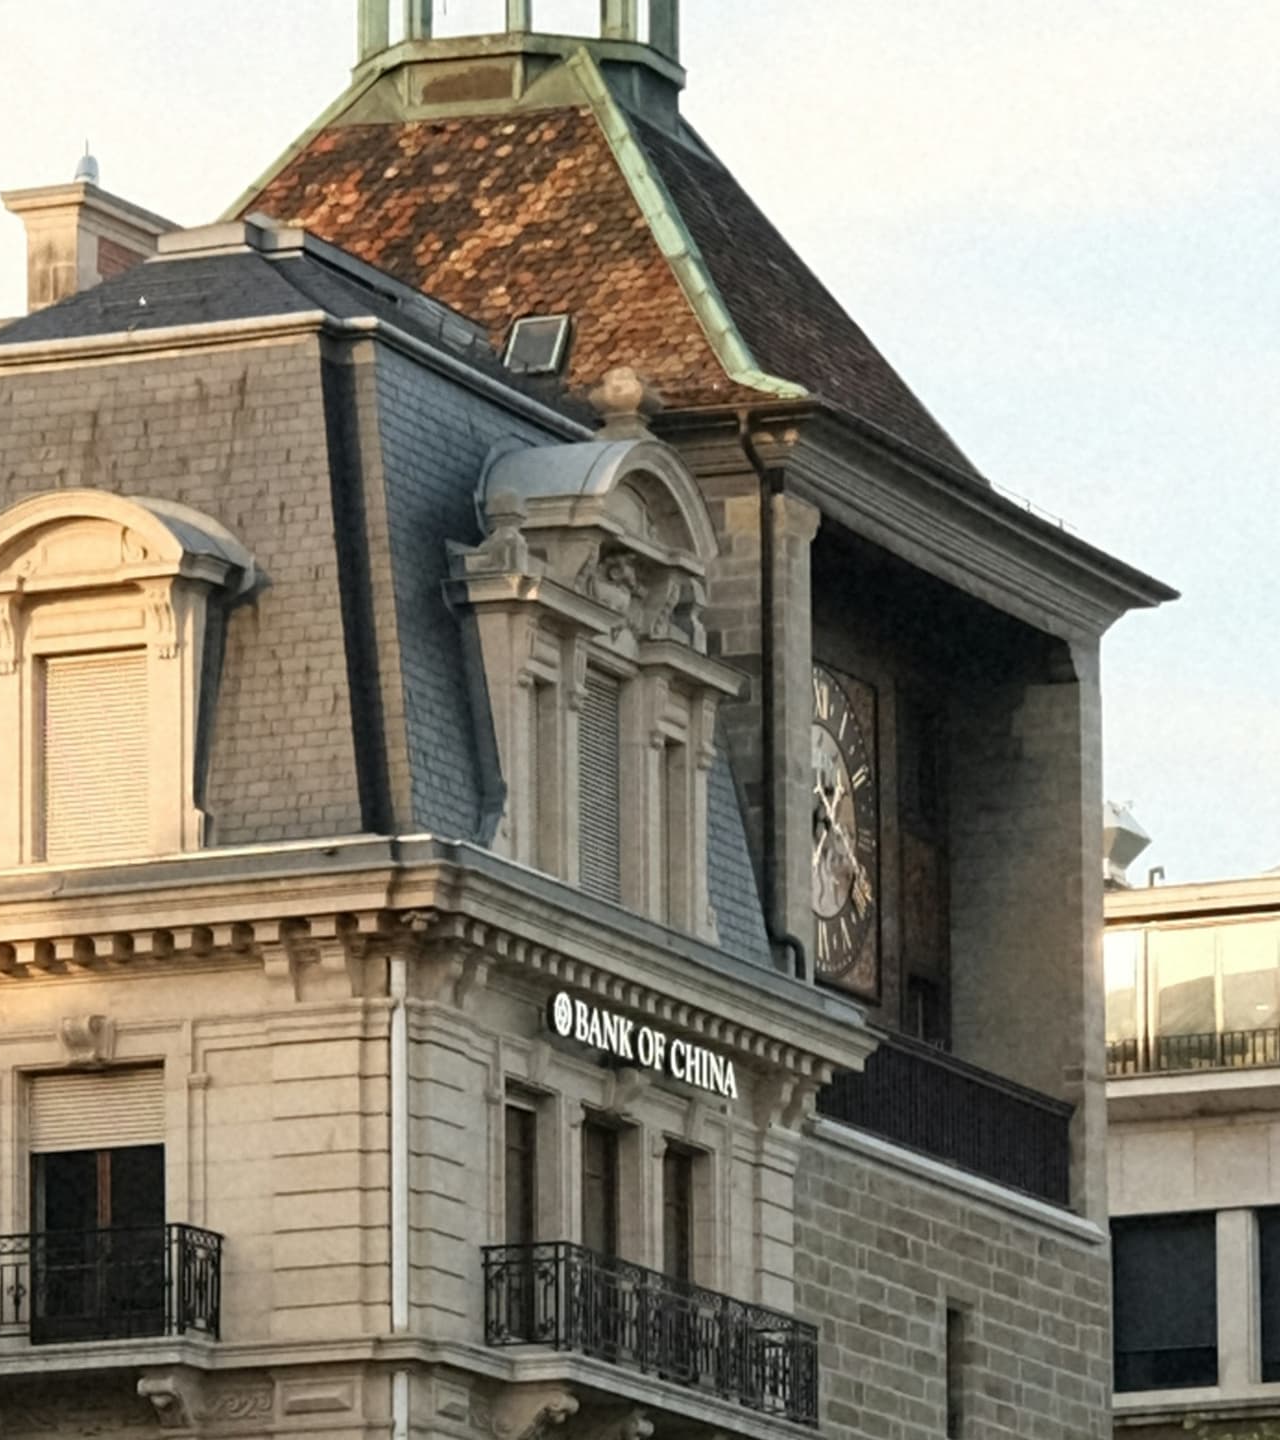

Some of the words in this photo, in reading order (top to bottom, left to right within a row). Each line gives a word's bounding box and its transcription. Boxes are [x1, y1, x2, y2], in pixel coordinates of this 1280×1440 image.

[574, 999, 634, 1060] BANK
[637, 1025, 667, 1071] OF
[670, 1038, 738, 1099] CHINA
